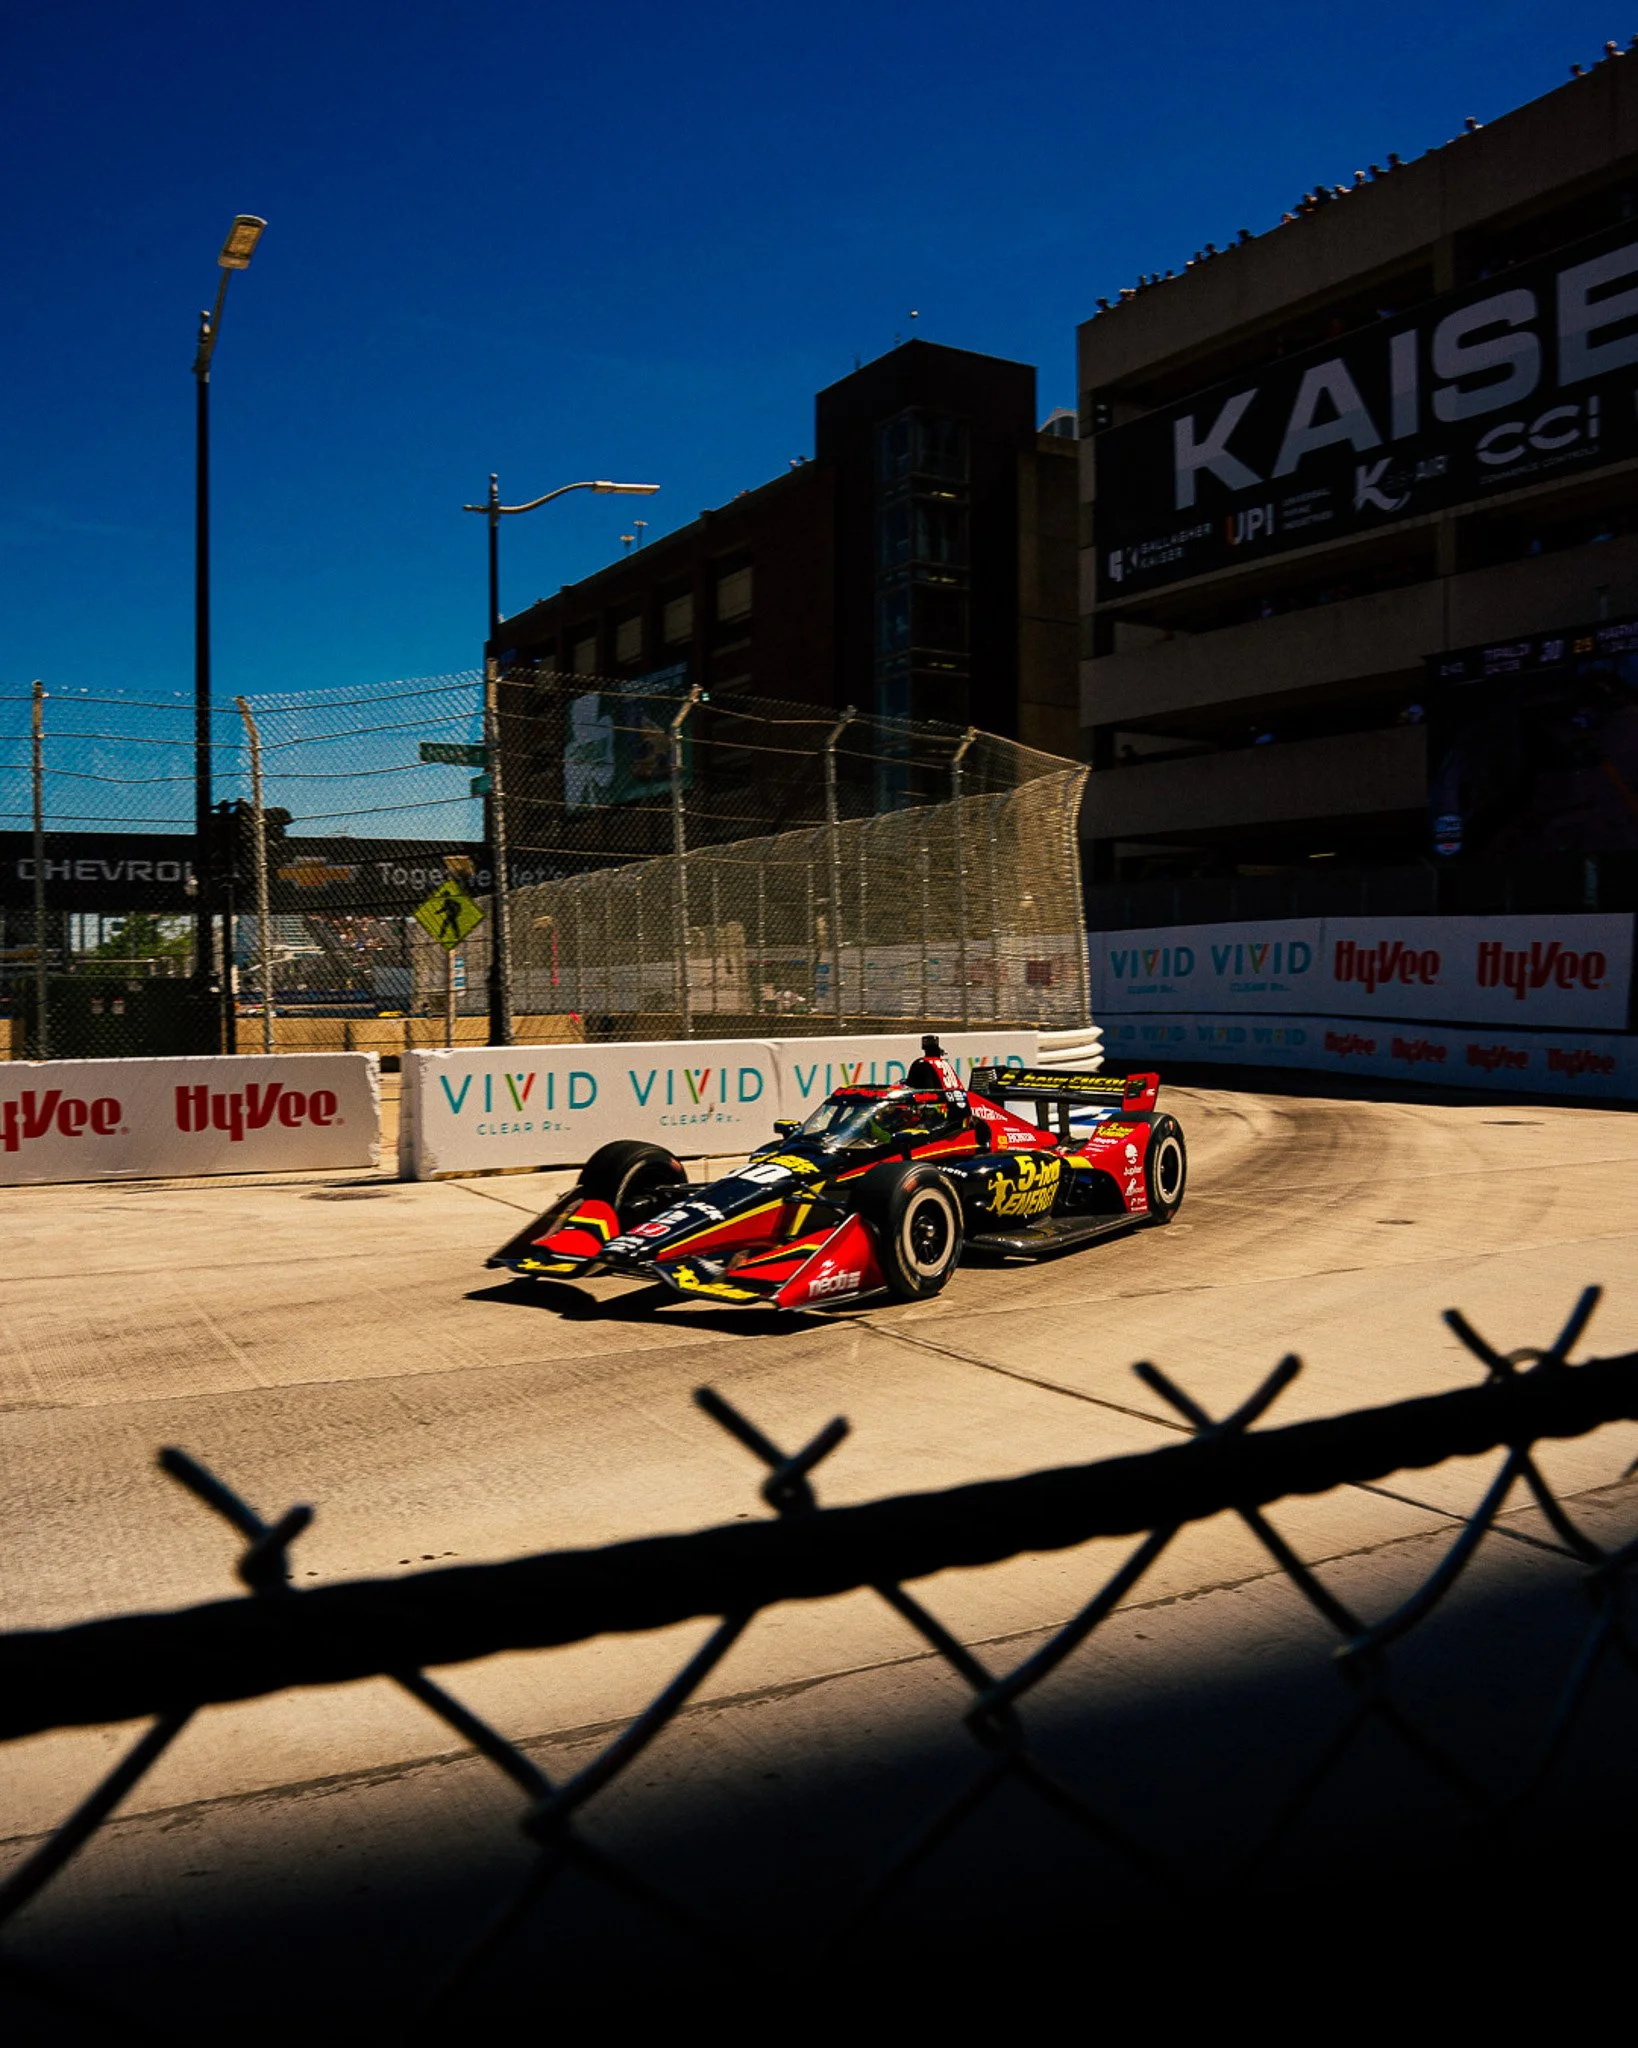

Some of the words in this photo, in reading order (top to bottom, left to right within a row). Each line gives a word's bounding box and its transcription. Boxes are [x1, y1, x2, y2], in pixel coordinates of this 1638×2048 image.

[1173, 241, 1638, 511] KAISE
[1225, 503, 1276, 548] UPI
[1110, 946, 1196, 979] VIVID
[1210, 941, 1312, 976] VIVID
[1335, 941, 1440, 993] HyVee
[1478, 941, 1607, 1000] HyVee
[440, 1072, 598, 1114] VIVID
[628, 1068, 764, 1106] VIVID
[794, 1060, 907, 1098] VIVID
[176, 1083, 338, 1142] HyVee
[476, 1122, 533, 1136] CLEAR
[659, 1114, 708, 1127] CLEAR
